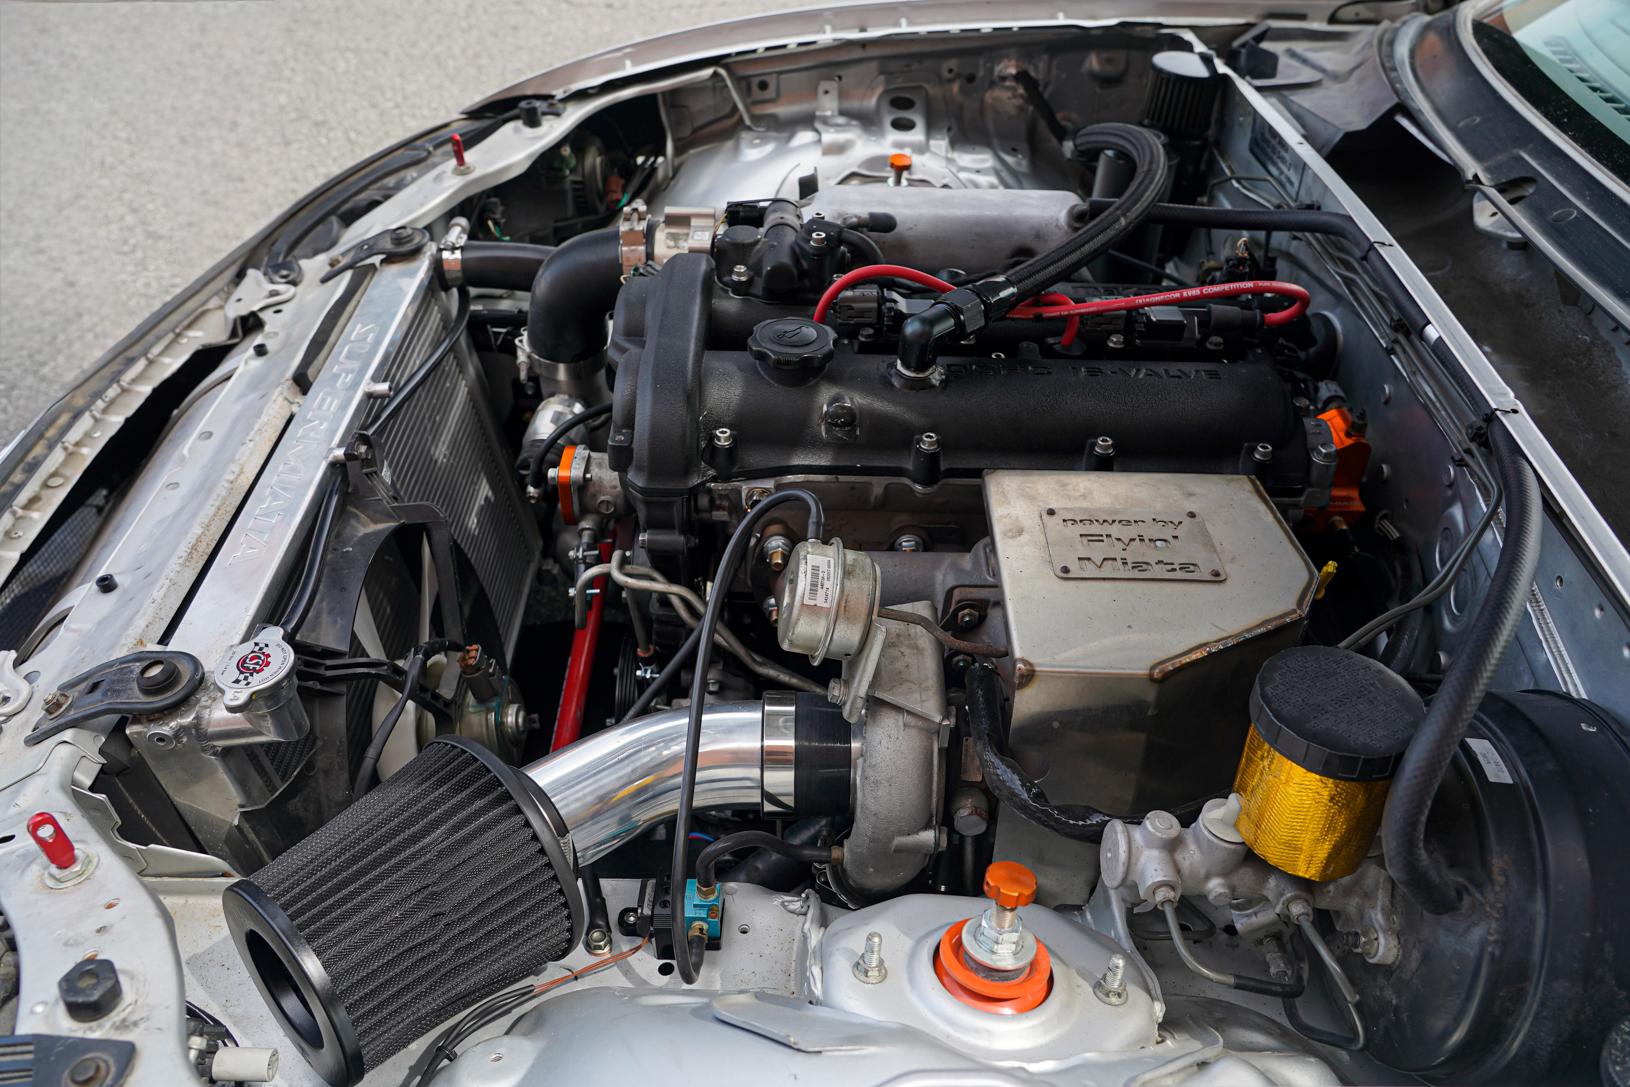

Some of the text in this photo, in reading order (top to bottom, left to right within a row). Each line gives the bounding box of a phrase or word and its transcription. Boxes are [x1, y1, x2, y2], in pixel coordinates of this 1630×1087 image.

[1202, 282, 1254, 294] COMPETITION
[1071, 366, 1222, 380] 16-VALVE
[226, 322, 379, 567] SUPERMIATA
[1062, 518, 1184, 530] power by
[1077, 556, 1202, 575] Miata
[243, 652, 265, 671] CSF
